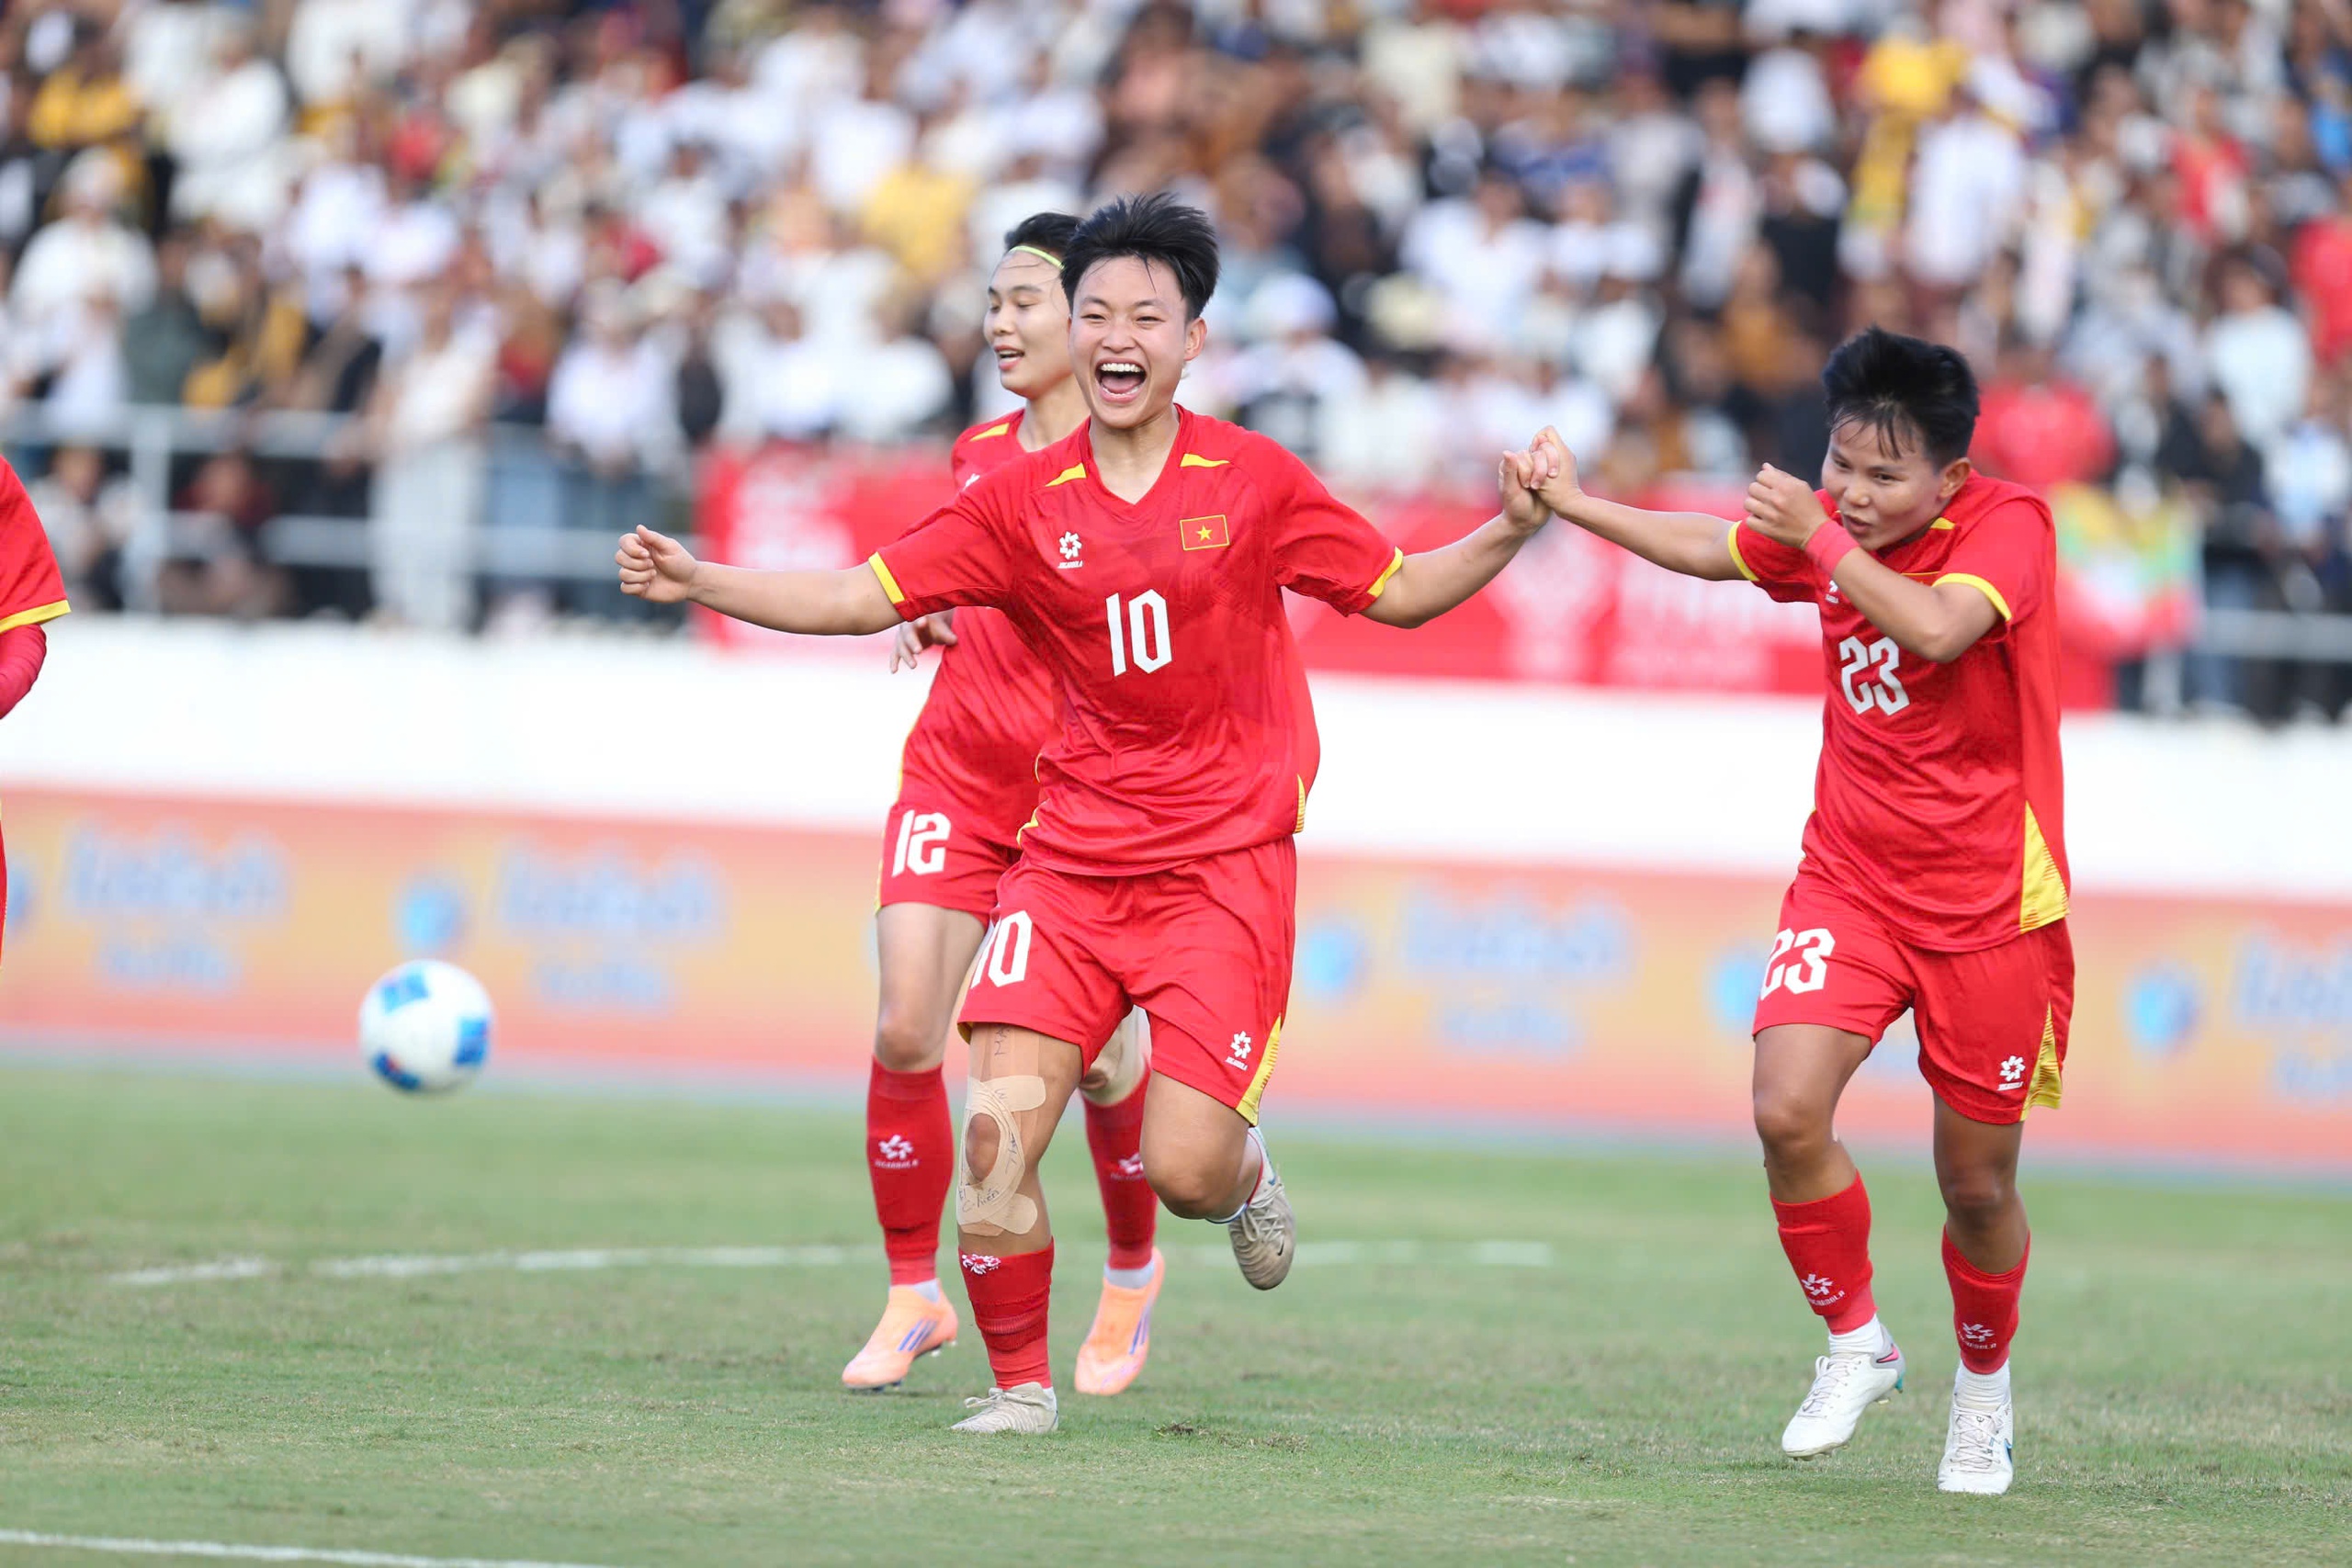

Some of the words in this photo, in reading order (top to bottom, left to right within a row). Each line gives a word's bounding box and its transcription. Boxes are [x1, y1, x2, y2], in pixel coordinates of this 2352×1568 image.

[1105, 588, 1172, 677] 10
[1839, 635, 1910, 716] 23
[891, 809, 951, 878] 12
[969, 909, 1033, 989] 10
[1760, 927, 1836, 1001] 23
